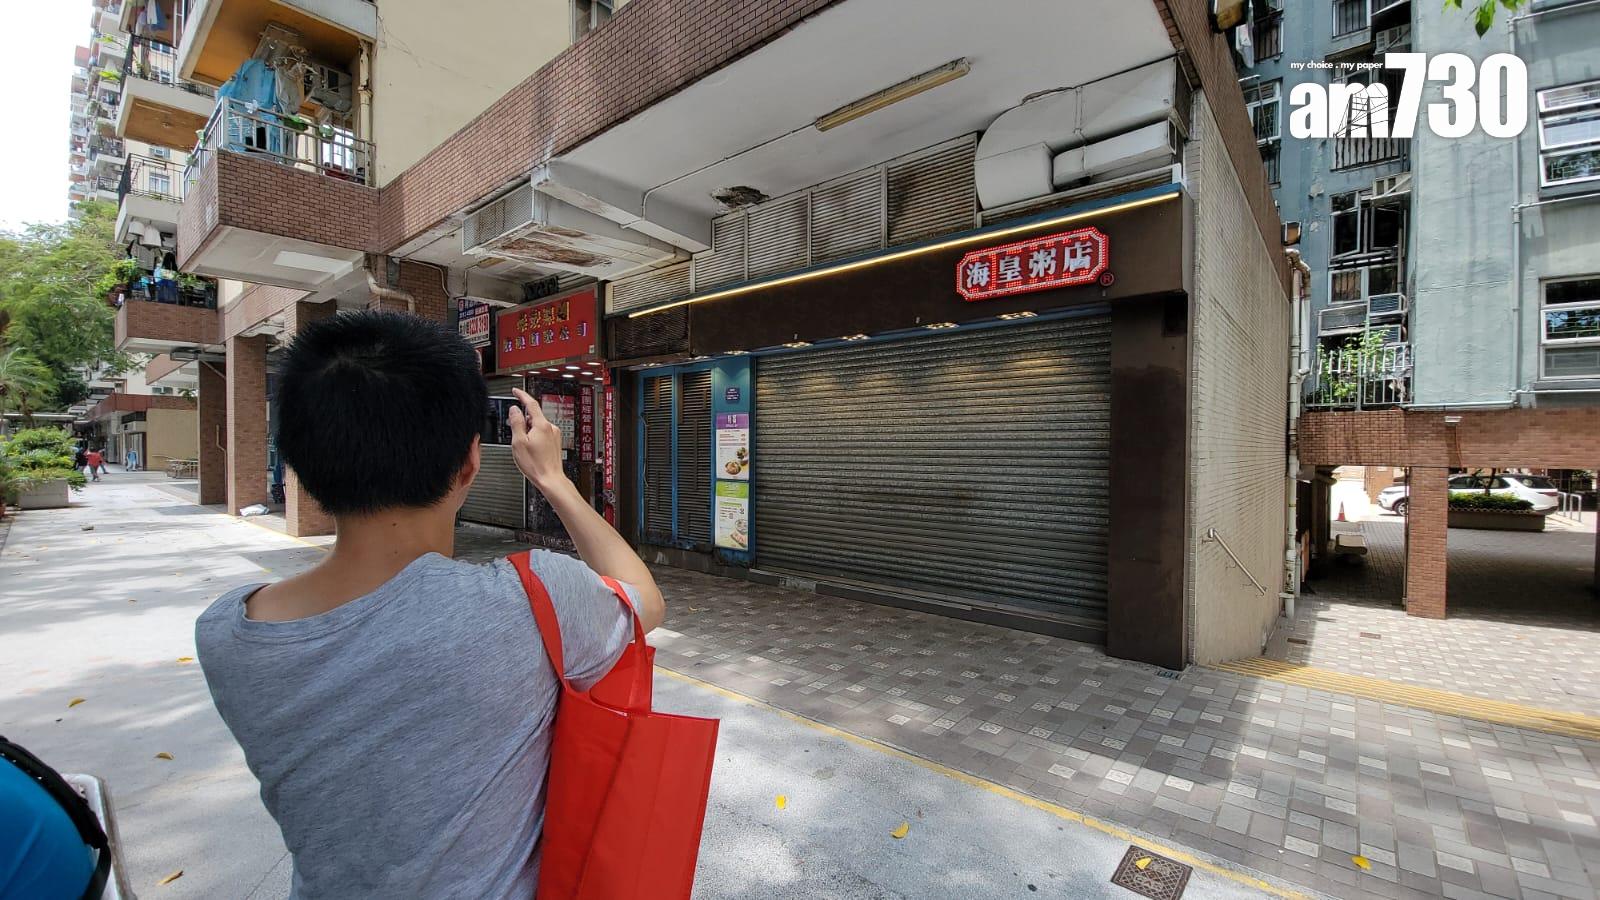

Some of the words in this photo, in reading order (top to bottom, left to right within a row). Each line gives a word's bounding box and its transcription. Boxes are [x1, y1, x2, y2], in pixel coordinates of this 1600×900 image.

[966, 241, 1094, 288] 海皇粥店
[581, 386, 593, 423] 集團經營
[581, 424, 593, 462] 信心保證
